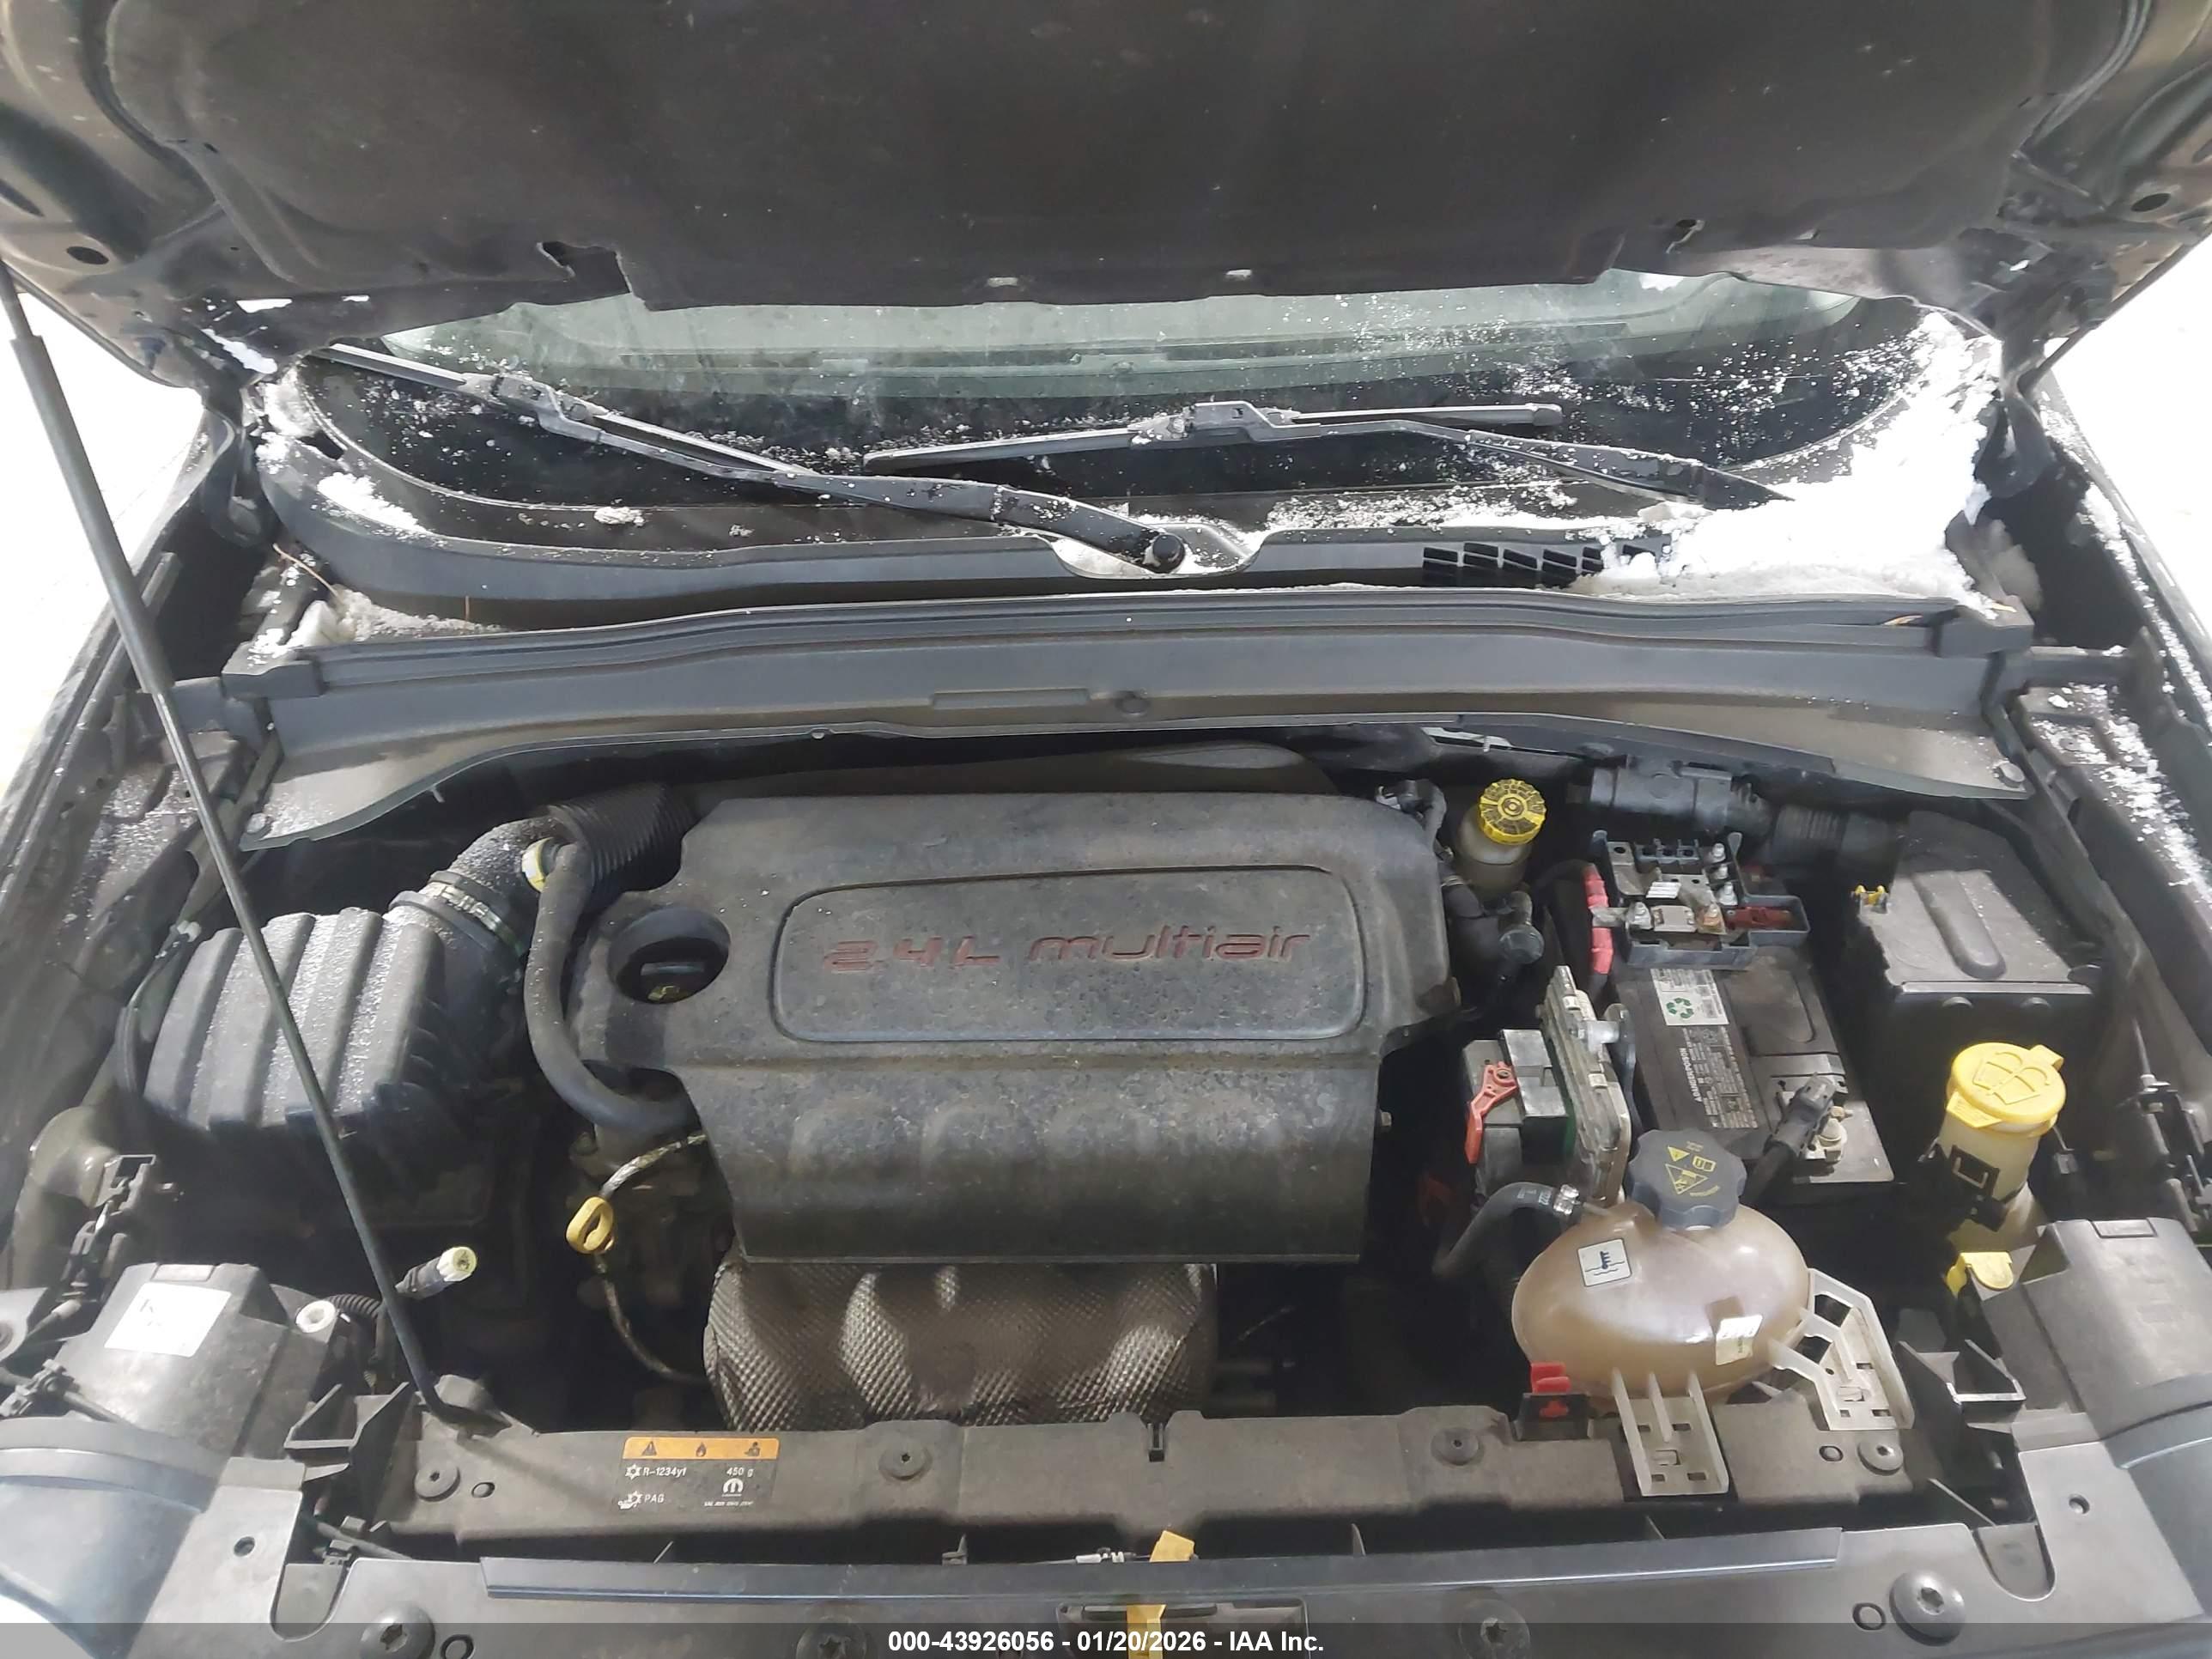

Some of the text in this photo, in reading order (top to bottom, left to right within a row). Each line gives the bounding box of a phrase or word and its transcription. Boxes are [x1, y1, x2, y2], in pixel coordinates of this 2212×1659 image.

[823, 925, 1311, 973] 2.4L multiair
[726, 1467, 744, 1477] 450
[644, 1493, 665, 1504] PAG
